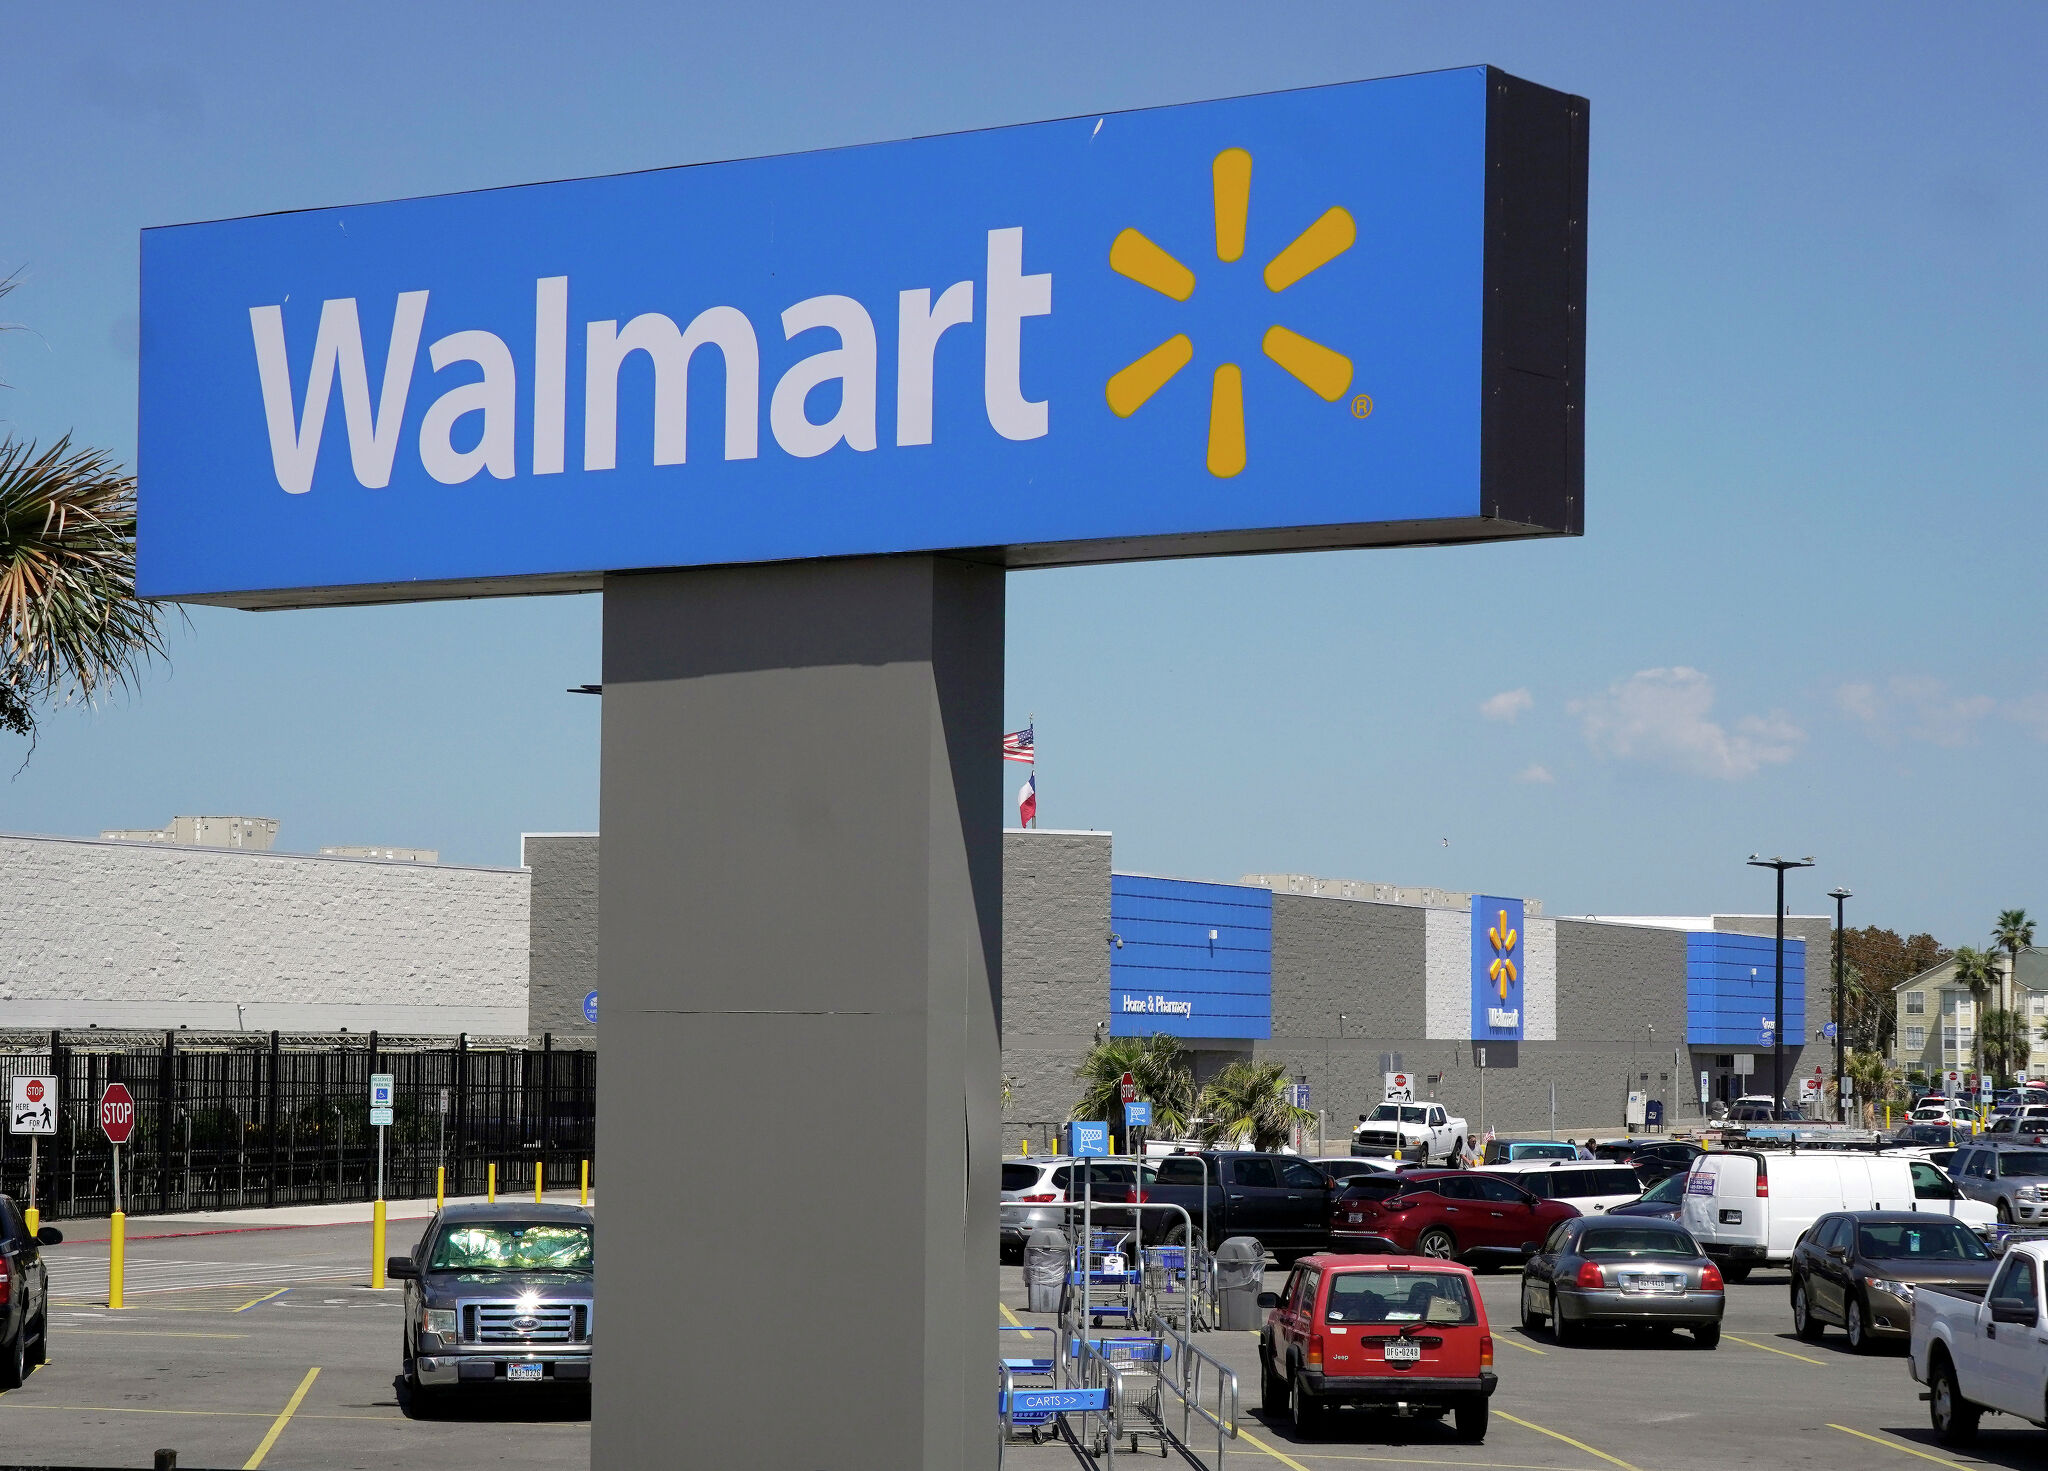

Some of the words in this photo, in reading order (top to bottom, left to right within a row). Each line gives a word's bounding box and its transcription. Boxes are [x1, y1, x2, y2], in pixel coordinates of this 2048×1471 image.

[249, 226, 1053, 494] Walmart
[1123, 994, 1147, 1013] Home
[1147, 995, 1155, 1013] &
[1155, 995, 1192, 1019] Pharmacy
[27, 1086, 44, 1096] STOP
[1122, 1084, 1134, 1098] STOP
[103, 1102, 132, 1124] STOP
[1332, 1353, 1349, 1361] Jeep
[1026, 1396, 1061, 1407] CARTS
